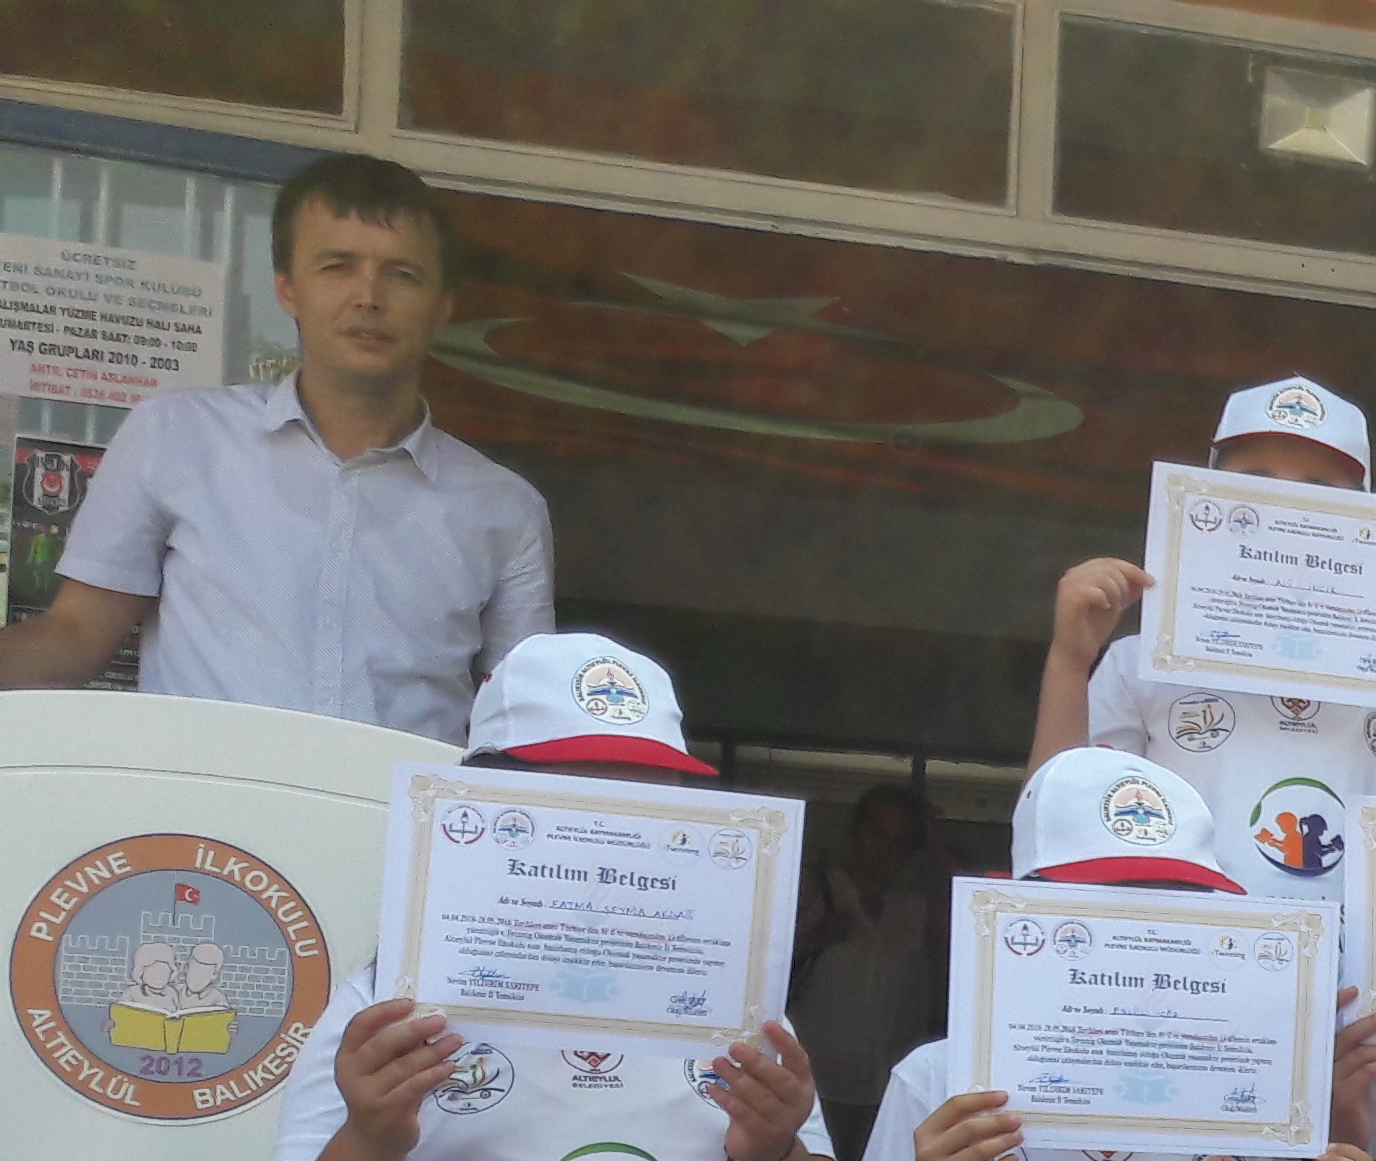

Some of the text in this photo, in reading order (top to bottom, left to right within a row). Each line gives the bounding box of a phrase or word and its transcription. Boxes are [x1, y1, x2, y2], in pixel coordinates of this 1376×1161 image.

[0, 318, 54, 333] UMARTESİ
[9, 338, 180, 371] YAŞ GRUPLARI 2010 2003
[1238, 544, 1364, 577] Katılım Belgesi
[506, 858, 678, 892] Katılım Belgesi
[29, 851, 132, 941] PLEVNE
[194, 844, 320, 958] İLKOKULU
[1068, 968, 1228, 996] Katılım Belgesi
[27, 1007, 315, 1109] ALTIEYLÜL BALIKESİR
[139, 1055, 204, 1077] 2012
